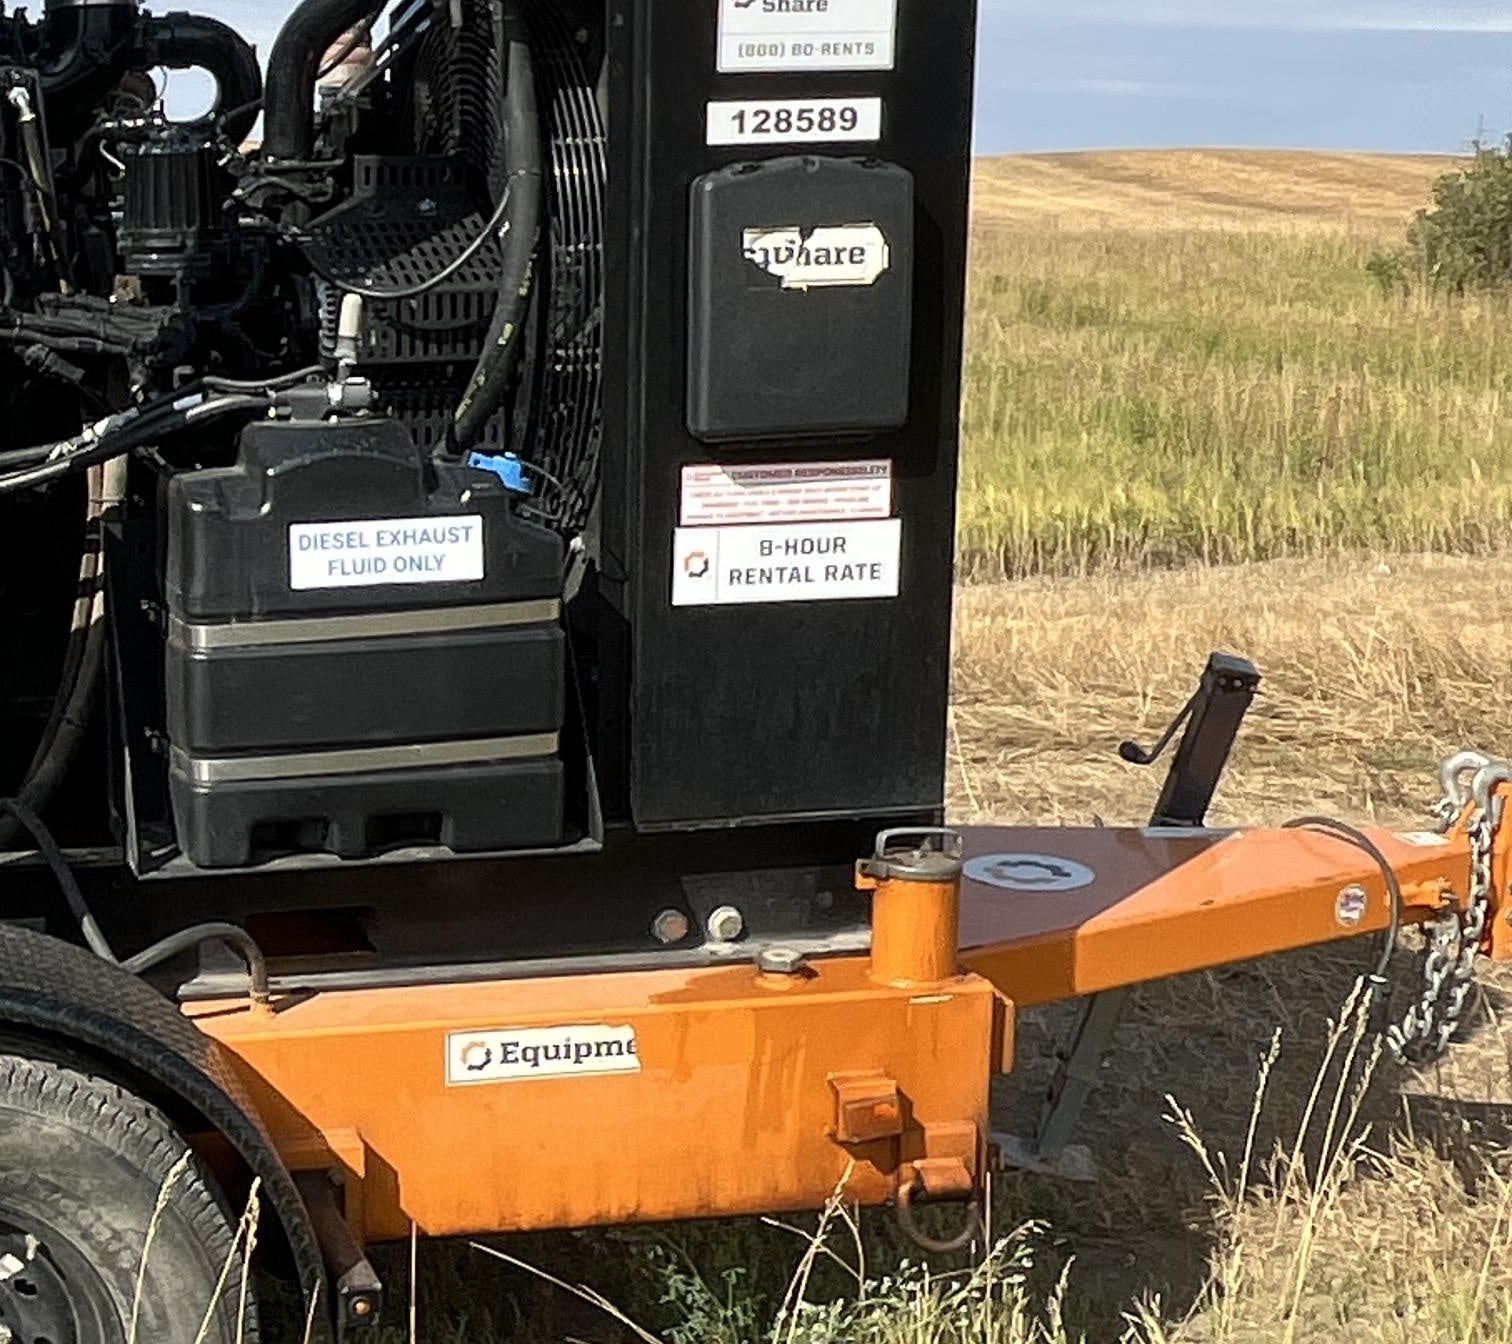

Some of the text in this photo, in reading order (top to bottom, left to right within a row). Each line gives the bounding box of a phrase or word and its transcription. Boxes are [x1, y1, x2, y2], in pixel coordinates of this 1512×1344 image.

[738, 42, 786, 59] (800)
[731, 107, 859, 135] 128589
[298, 525, 474, 552] DIESEL EXHAUST
[759, 536, 847, 557] 8-HOUR
[327, 554, 446, 576] FLUID ONLY
[728, 562, 883, 586] RENTAL RATE
